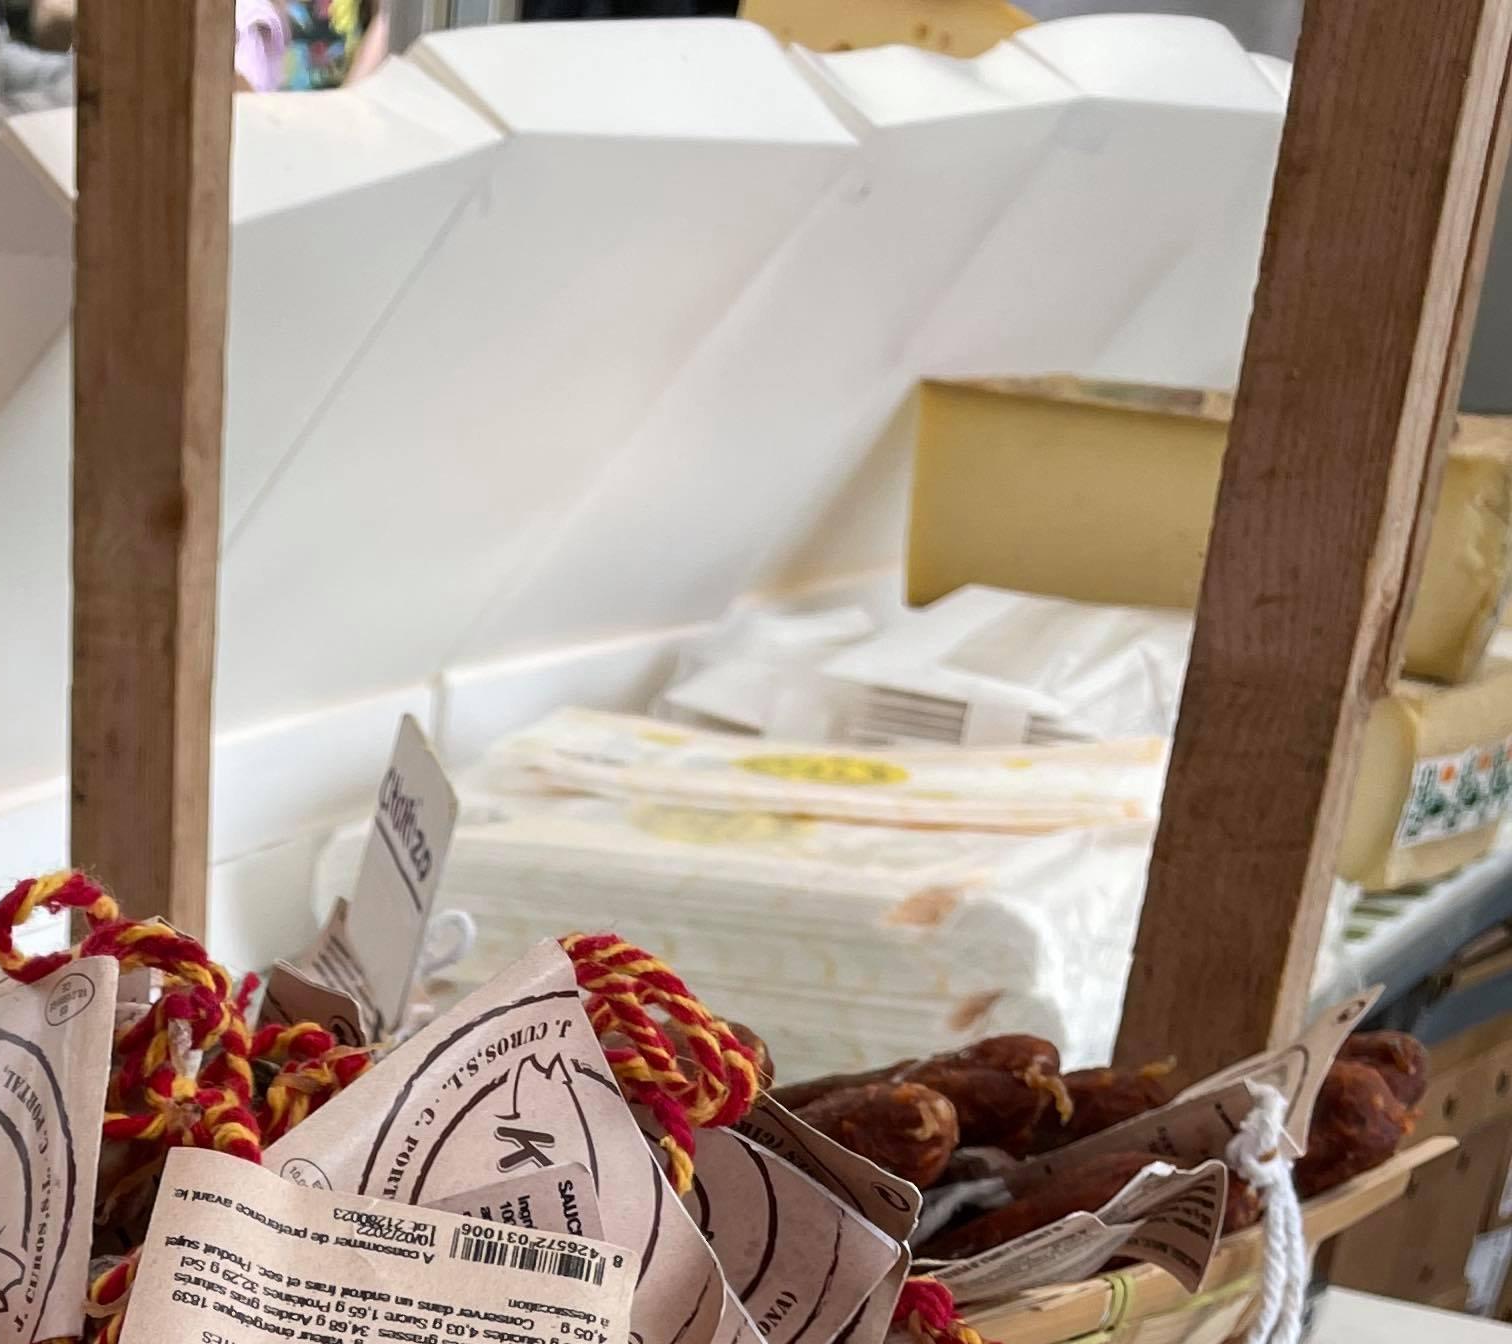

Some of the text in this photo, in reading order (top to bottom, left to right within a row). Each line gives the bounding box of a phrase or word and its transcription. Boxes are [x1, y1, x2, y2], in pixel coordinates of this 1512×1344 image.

[554, 1019, 573, 1039] J.
[414, 1106, 436, 1128] C.
[190, 1189, 419, 1259] consommer de avant
[461, 1222, 623, 1268] 8 426572 031006
[179, 1255, 206, 1271] Sel
[164, 1234, 607, 1344] 4,05 Conserver dans un endroit frais Produit sujet
[173, 1271, 229, 1295] saturés
[218, 1268, 262, 1294] 32,29
[171, 1288, 207, 1308] 1839
[229, 1289, 260, 1309] gras
[212, 1301, 299, 1340] énergétique
[263, 1304, 313, 1326] Acides
[347, 1305, 378, 1321] 1,65
[383, 1311, 428, 1329] Sucre
[328, 1319, 370, 1337] 34,68
[445, 1322, 479, 1338] 4,03
